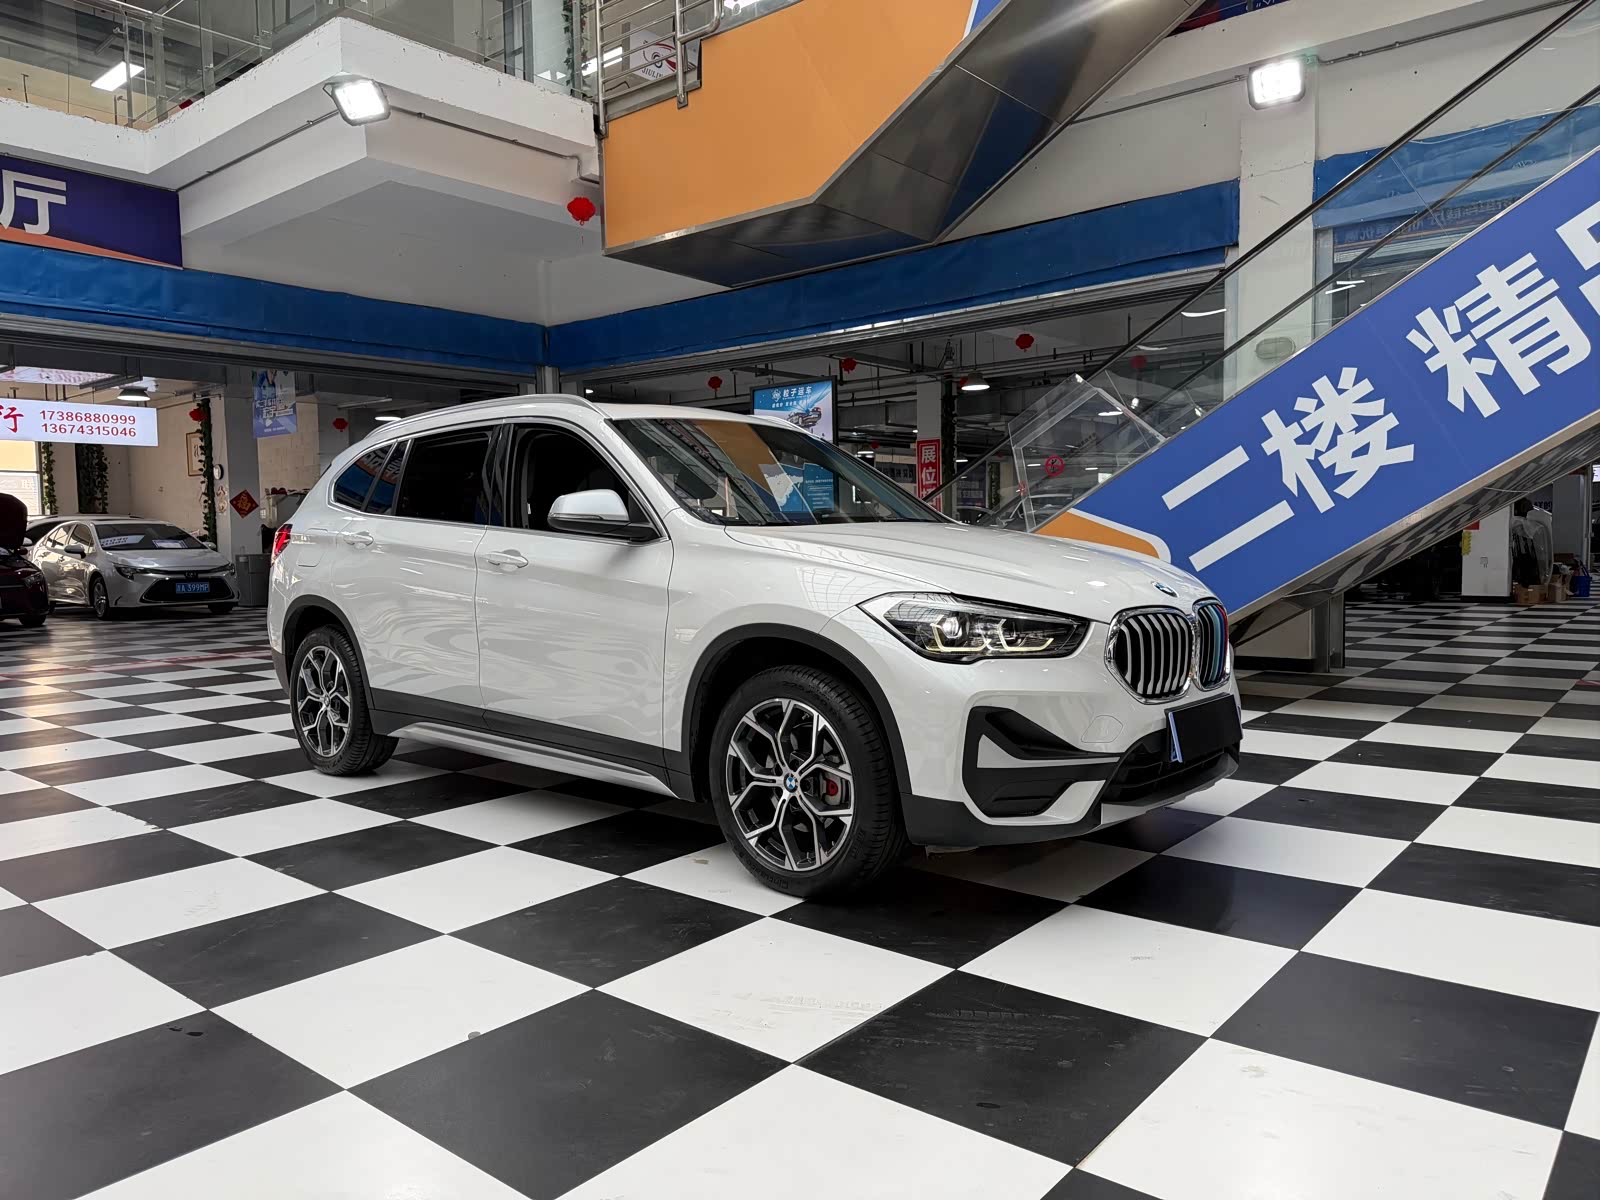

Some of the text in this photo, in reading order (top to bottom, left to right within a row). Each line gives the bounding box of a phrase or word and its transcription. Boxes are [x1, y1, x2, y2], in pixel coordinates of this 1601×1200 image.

[0, 169, 67, 235] 厅
[1162, 201, 1600, 572] 二楼 精
[40, 410, 136, 425] 17386880999
[42, 423, 137, 437] 13674315046
